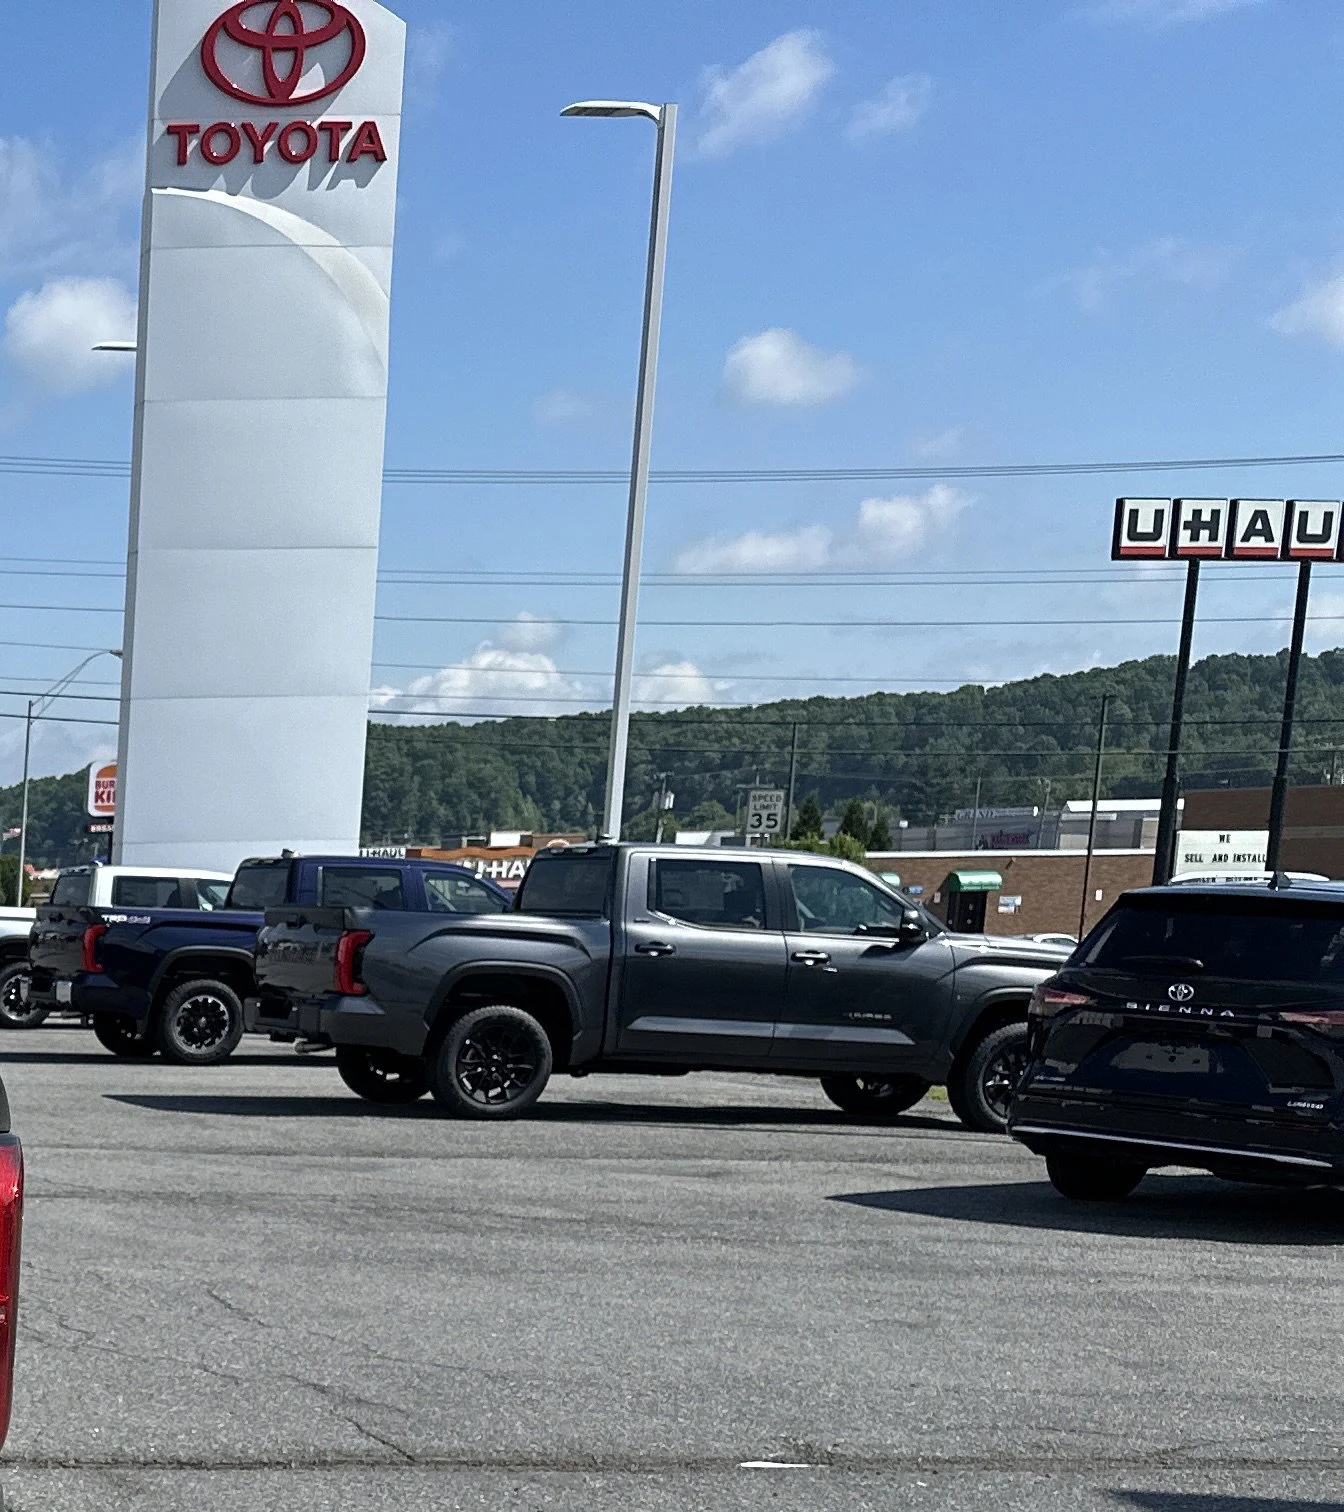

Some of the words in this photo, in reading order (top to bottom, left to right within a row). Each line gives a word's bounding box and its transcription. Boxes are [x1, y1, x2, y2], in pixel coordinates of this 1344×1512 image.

[167, 121, 387, 166] TOYOTA
[95, 780, 116, 790] BUR
[95, 790, 116, 804] KI
[752, 794, 782, 803] SPEED
[753, 803, 777, 811] LIMIT
[750, 813, 778, 829] 35
[1219, 834, 1231, 844] WE
[1184, 853, 1204, 863] SELL
[1212, 853, 1229, 863] AND
[1232, 853, 1267, 863] INSTALL
[1126, 1002, 1235, 1018] SIENNA
